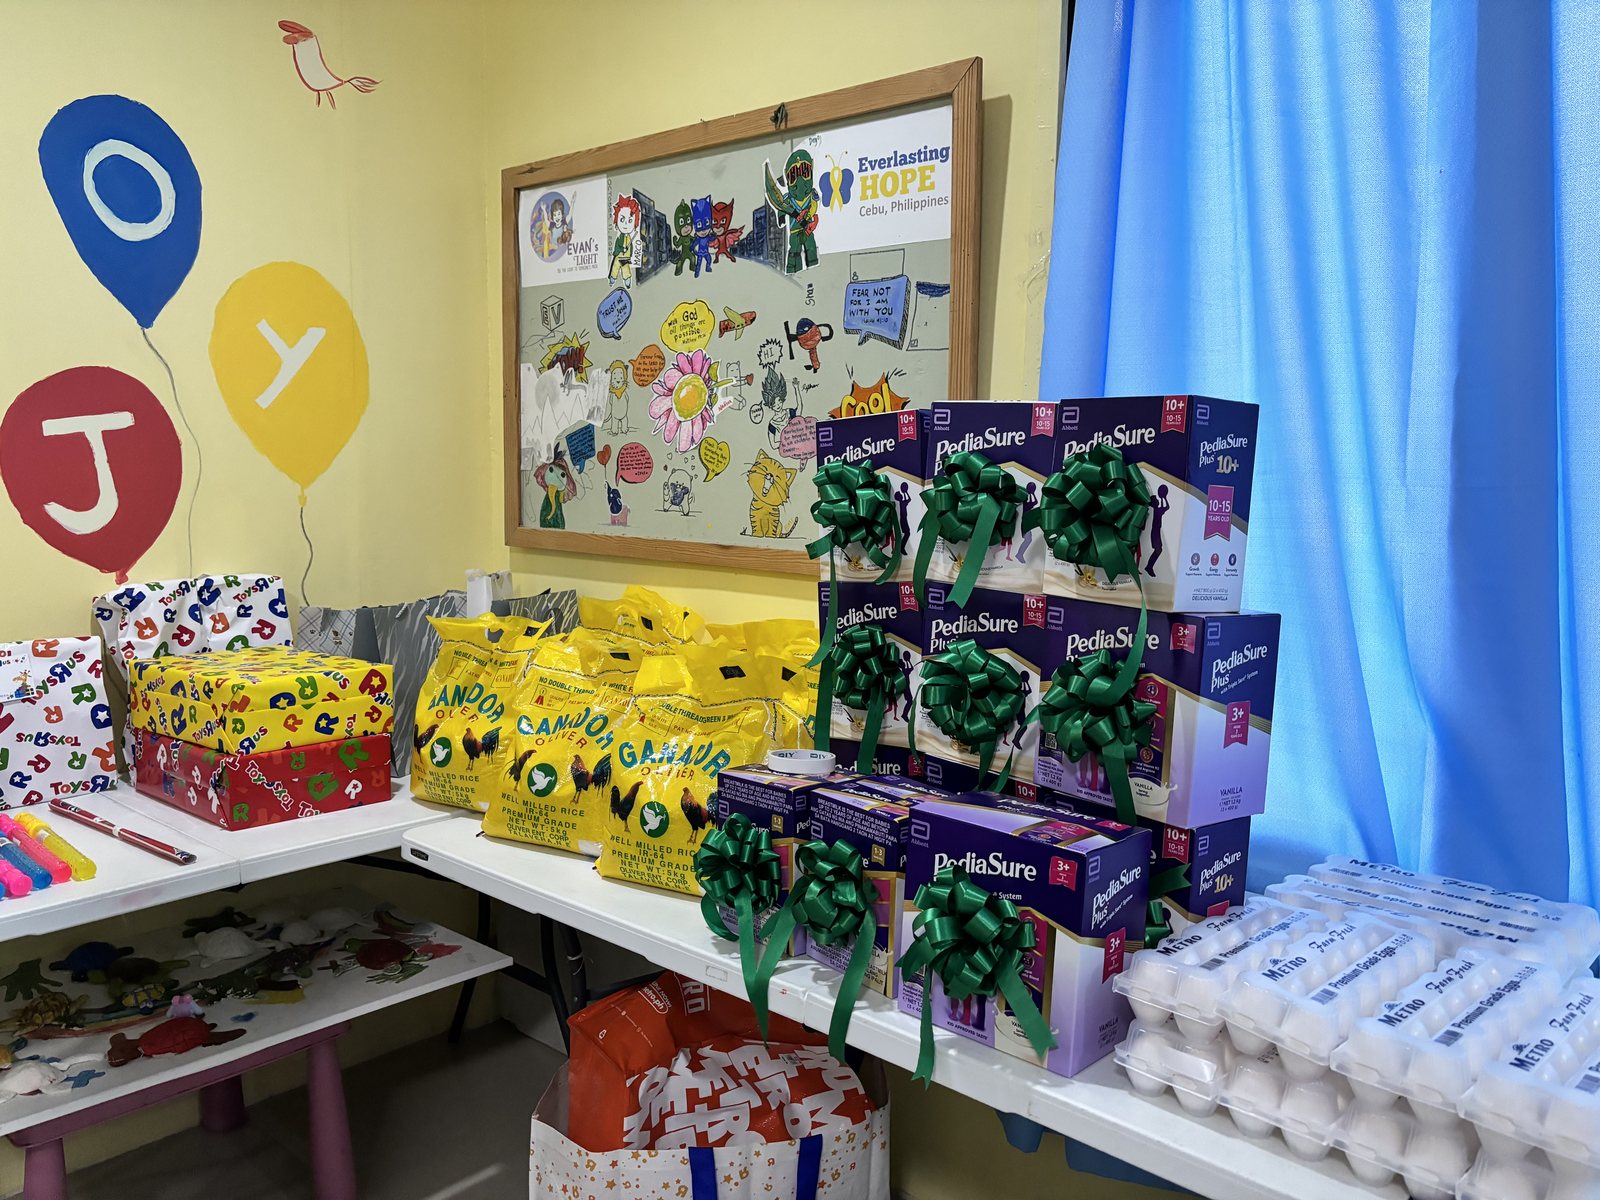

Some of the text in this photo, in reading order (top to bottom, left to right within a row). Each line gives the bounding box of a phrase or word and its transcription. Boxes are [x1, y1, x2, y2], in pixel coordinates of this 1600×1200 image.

[858, 145, 950, 173] Everlasting
[860, 164, 936, 201] HOPE
[860, 195, 949, 217] Cebu, Philippines
[852, 286, 892, 297] FEAR NOT
[682, 308, 698, 321] God
[849, 307, 893, 317] WITH YOU
[255, 318, 326, 409] Y
[1035, 406, 1053, 418] 10+
[1165, 399, 1185, 411] 10+
[899, 414, 915, 424] 10+
[935, 427, 1026, 462] PediaSure
[1064, 424, 1156, 459] PediaSure
[1200, 434, 1248, 457] PediaSure
[42, 411, 134, 534] J
[1216, 455, 1240, 474] 10+
[1208, 499, 1231, 512] 10-15
[1026, 597, 1044, 609] 10+
[837, 603, 897, 629] ediaSure
[1028, 611, 1042, 619] 10-15
[931, 612, 1018, 640] PediaSure
[1177, 627, 1190, 636] 3+
[1066, 627, 1159, 657] PediaSue
[1212, 644, 1268, 679] PediaSure
[539, 676, 547, 684] NO
[548, 678, 573, 691] DOUBLE
[607, 682, 628, 691] WHITE
[1211, 675, 1230, 693] Plus
[678, 708, 703, 723] THREAD
[702, 715, 721, 724] GREEN
[1231, 707, 1244, 721] 3+
[429, 771, 457, 780] MILLED
[449, 785, 476, 793] GRADE
[1018, 785, 1034, 796] 10+
[1220, 786, 1243, 796] VANILLA
[501, 791, 585, 817] WELL MILLED RICE
[525, 807, 549, 818] IR-64
[502, 807, 577, 830] PREMIUM GRADE
[508, 816, 526, 827] NET
[911, 839, 929, 848] Abbott
[1166, 828, 1187, 842] 10+
[610, 834, 696, 857] WELL MILLED RIC
[1168, 843, 1184, 853] 10-15
[612, 850, 695, 873] PREMIUM GRADE
[639, 850, 665, 860] IR-64
[620, 859, 642, 869] NET
[934, 852, 1036, 882] PediaSure
[1056, 860, 1070, 871] 3+
[1200, 851, 1241, 884] PediaSure
[1349, 858, 1415, 877] METRO
[1092, 865, 1141, 915] PediaSure
[1214, 873, 1234, 893] 10+
[998, 892, 1022, 901] System
[1110, 936, 1121, 952] 3+
[1156, 935, 1202, 956] METRO
[1219, 941, 1250, 958] Premium
[1262, 956, 1307, 982] METRO
[1328, 964, 1362, 990] Premium
[1356, 950, 1382, 970] Grade
[1377, 998, 1425, 1027] METRO
[1451, 1006, 1488, 1030] Premium
[1479, 987, 1507, 1008] Grade
[955, 1023, 975, 1036] APPROVED
[1509, 1038, 1555, 1072] METRO
